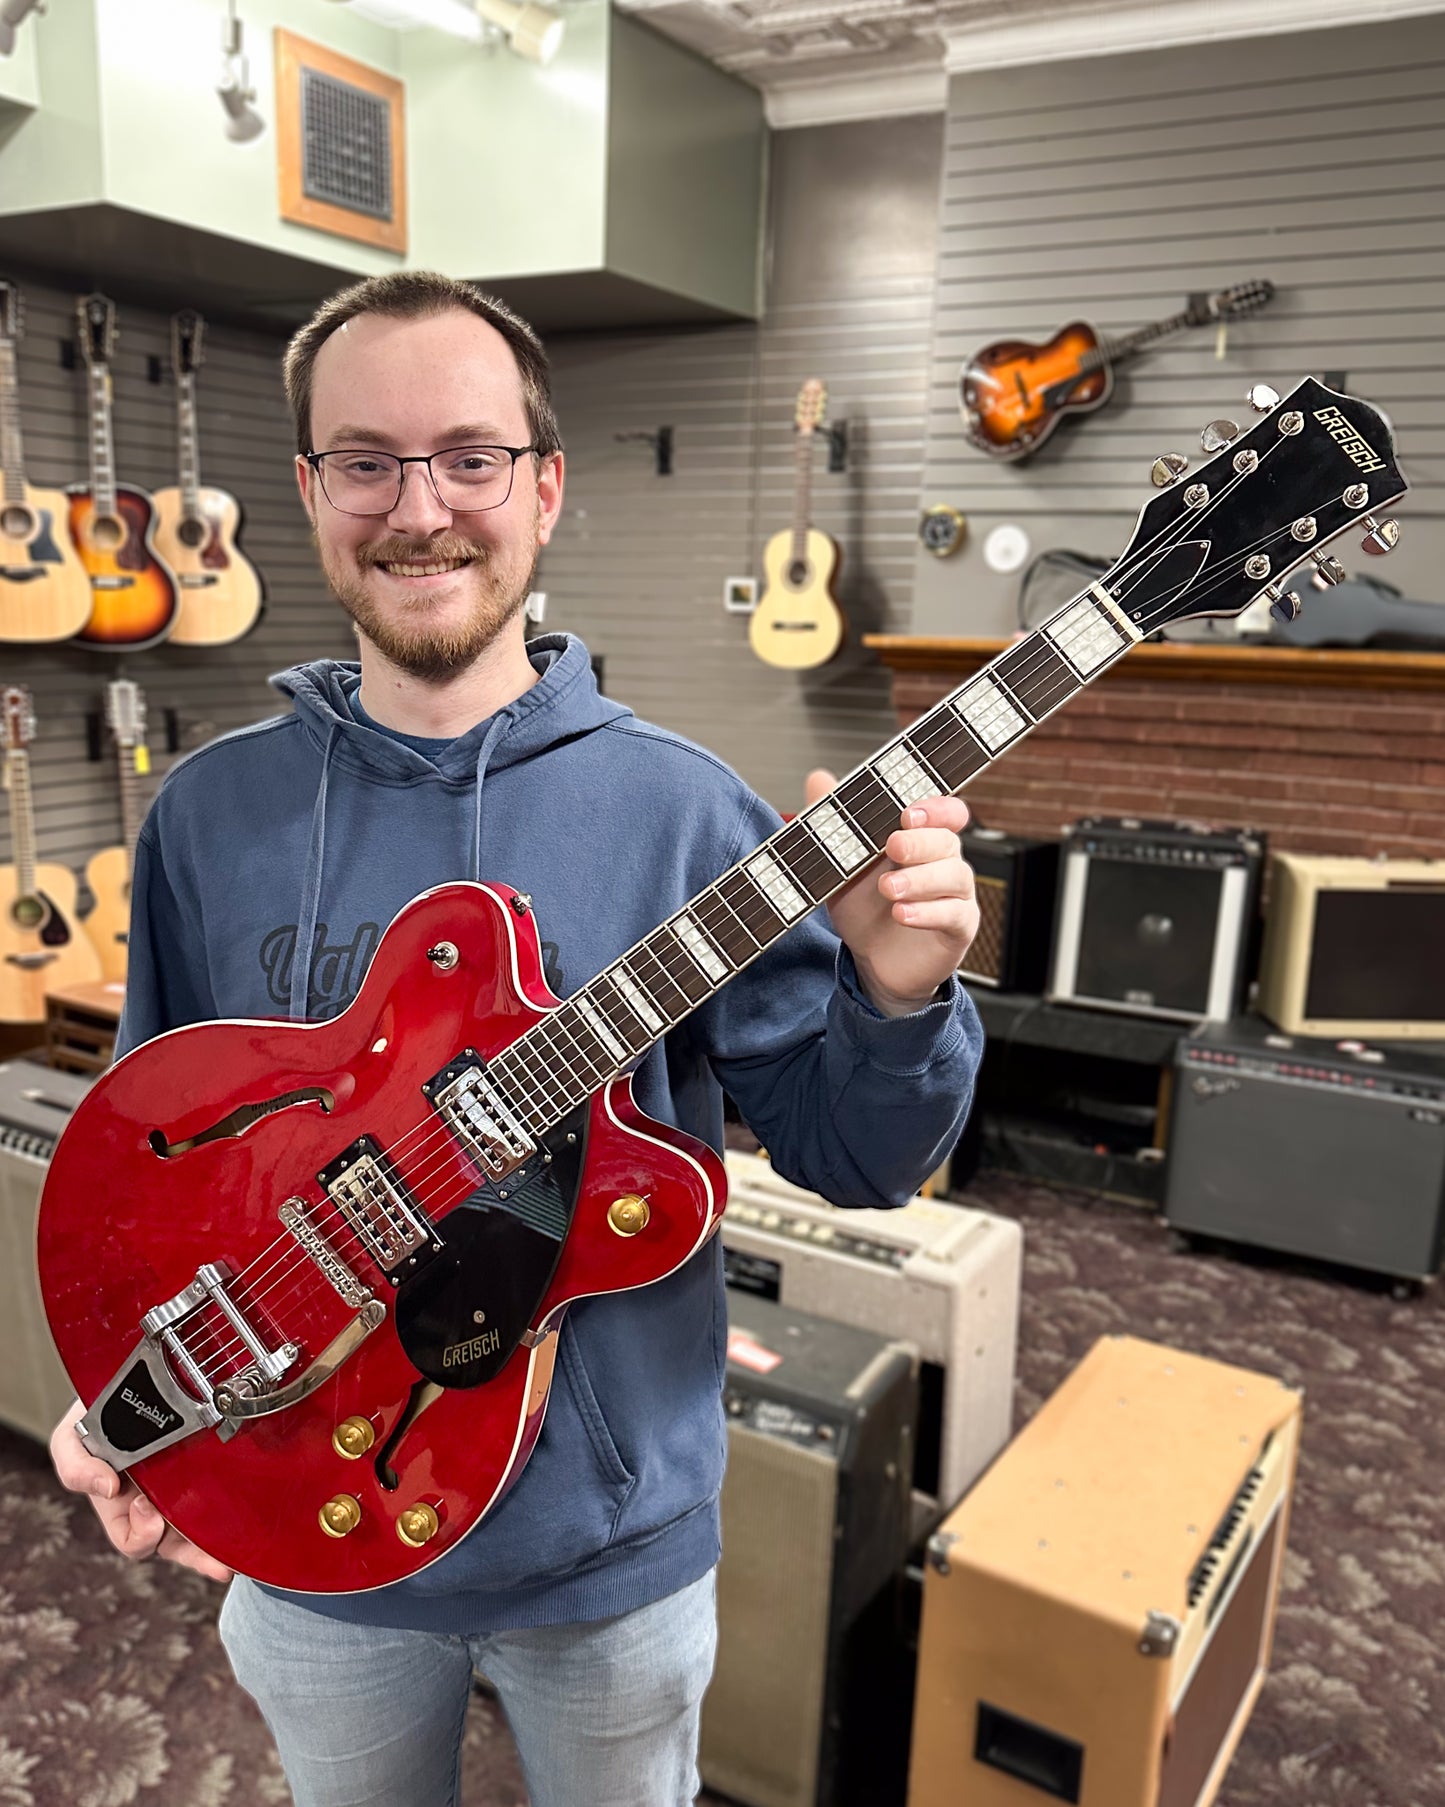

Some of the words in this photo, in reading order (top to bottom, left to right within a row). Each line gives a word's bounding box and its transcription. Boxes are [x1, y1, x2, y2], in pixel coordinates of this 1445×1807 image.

[1312, 405, 1387, 474] GRETSCH
[259, 921, 380, 1018] Ugl
[442, 1328, 500, 1368] GRETSCH
[120, 1387, 169, 1430] Bigsby
